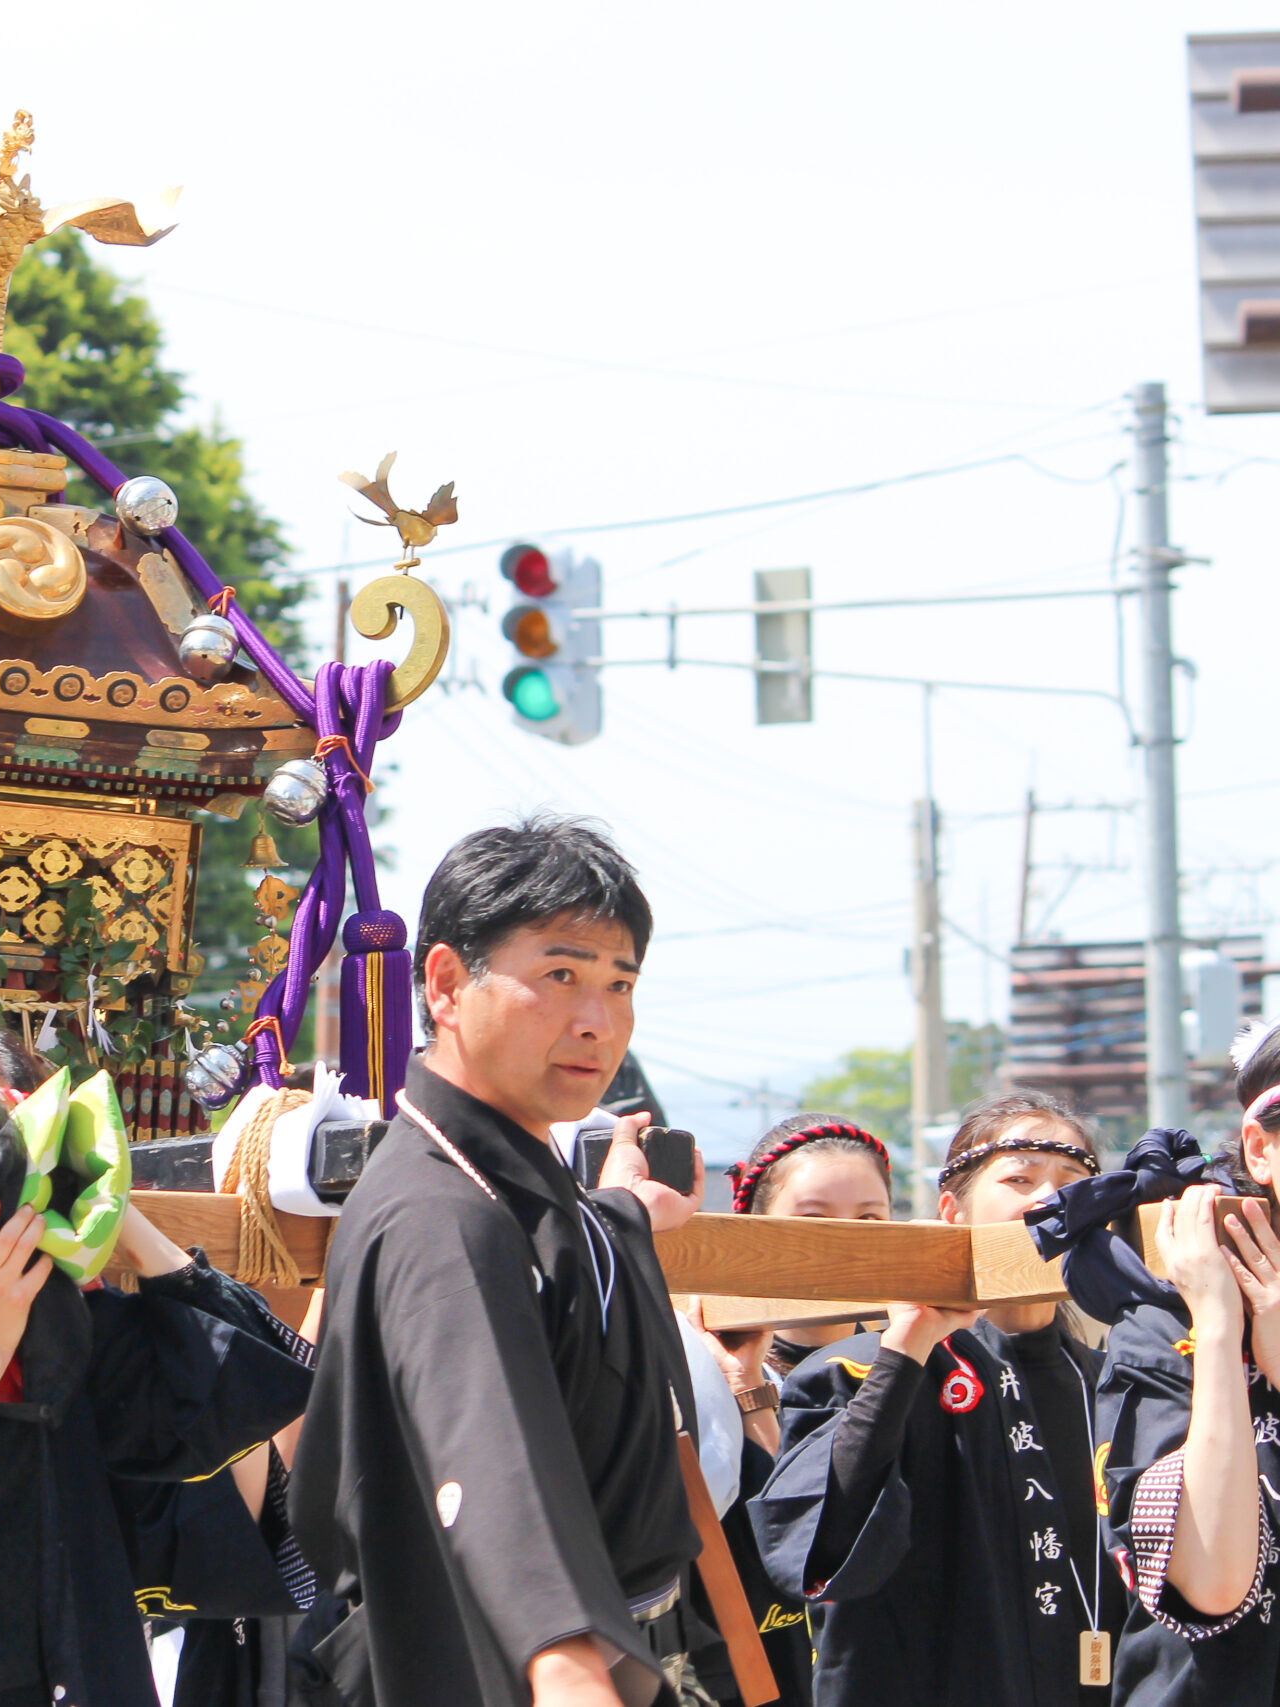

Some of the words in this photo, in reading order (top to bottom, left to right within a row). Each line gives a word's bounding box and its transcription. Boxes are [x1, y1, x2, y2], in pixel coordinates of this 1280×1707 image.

[999, 1366, 1063, 1616] 井波八幡宮
